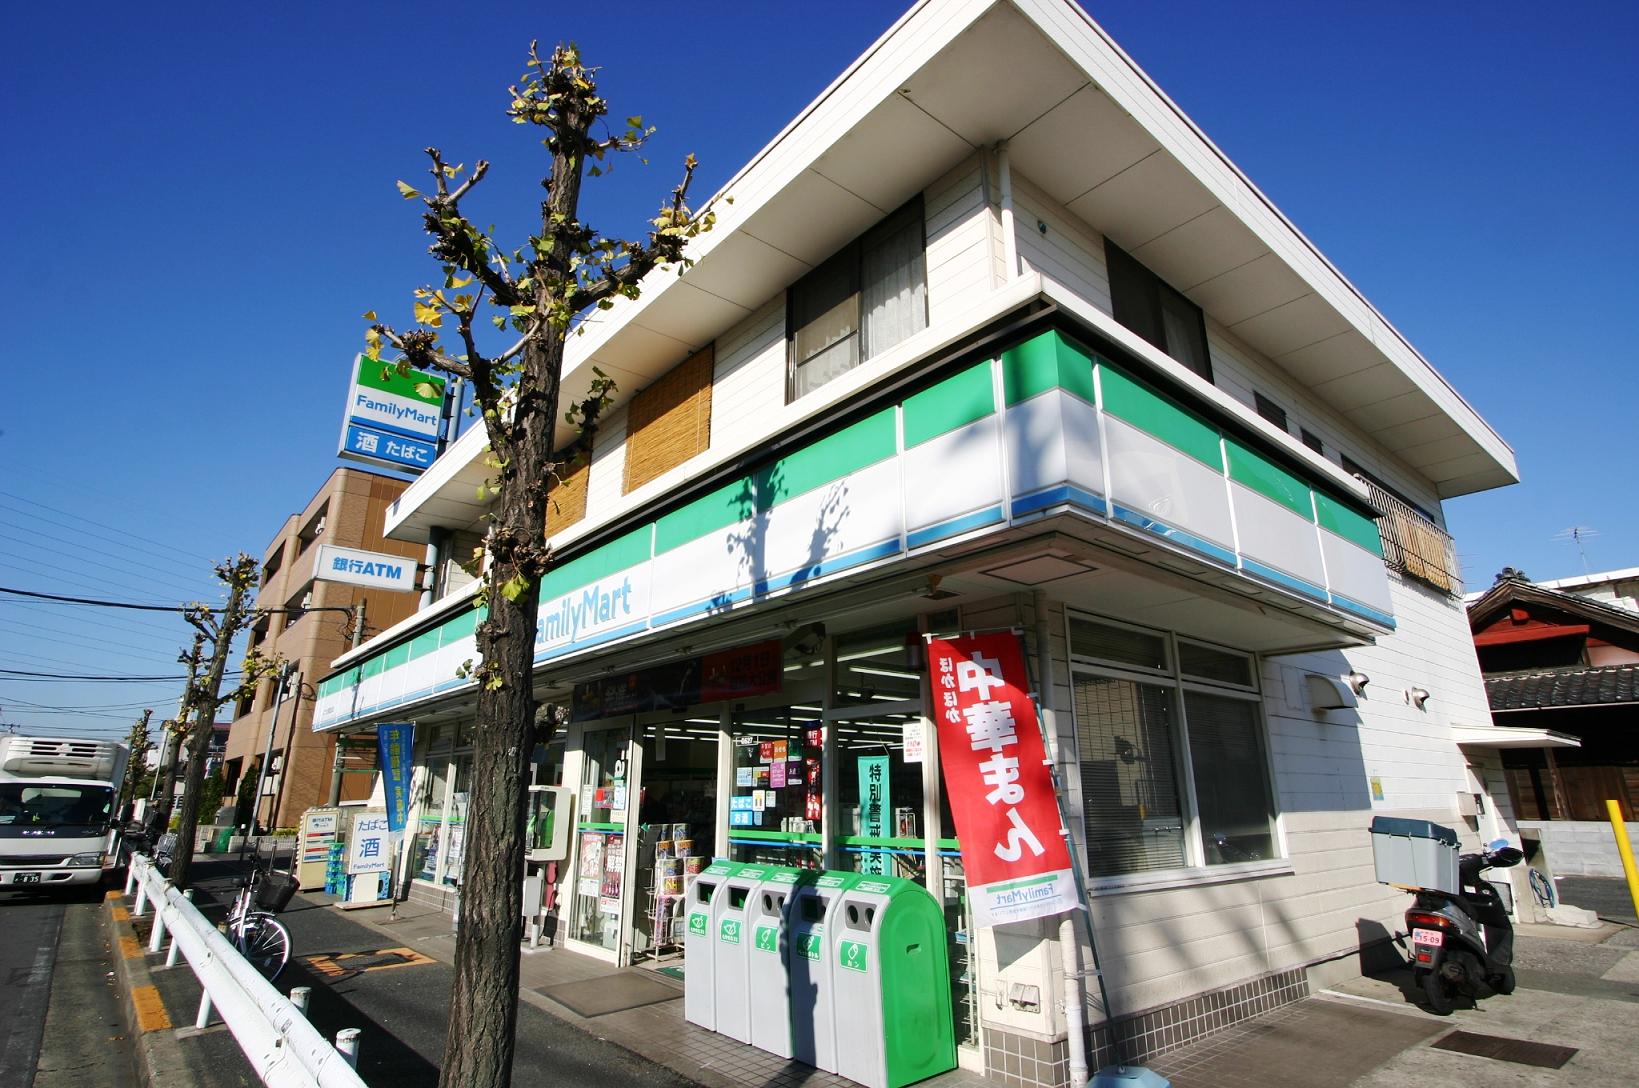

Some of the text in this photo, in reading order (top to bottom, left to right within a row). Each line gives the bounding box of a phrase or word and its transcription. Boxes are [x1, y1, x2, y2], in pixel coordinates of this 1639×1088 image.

[357, 395, 437, 427] FamilyMart
[356, 432, 428, 463] 酒 たばこ
[332, 556, 402, 579] 銀行ATM
[536, 576, 632, 643] amilyMart
[358, 819, 389, 831] たばこ
[360, 837, 381, 857] 酒
